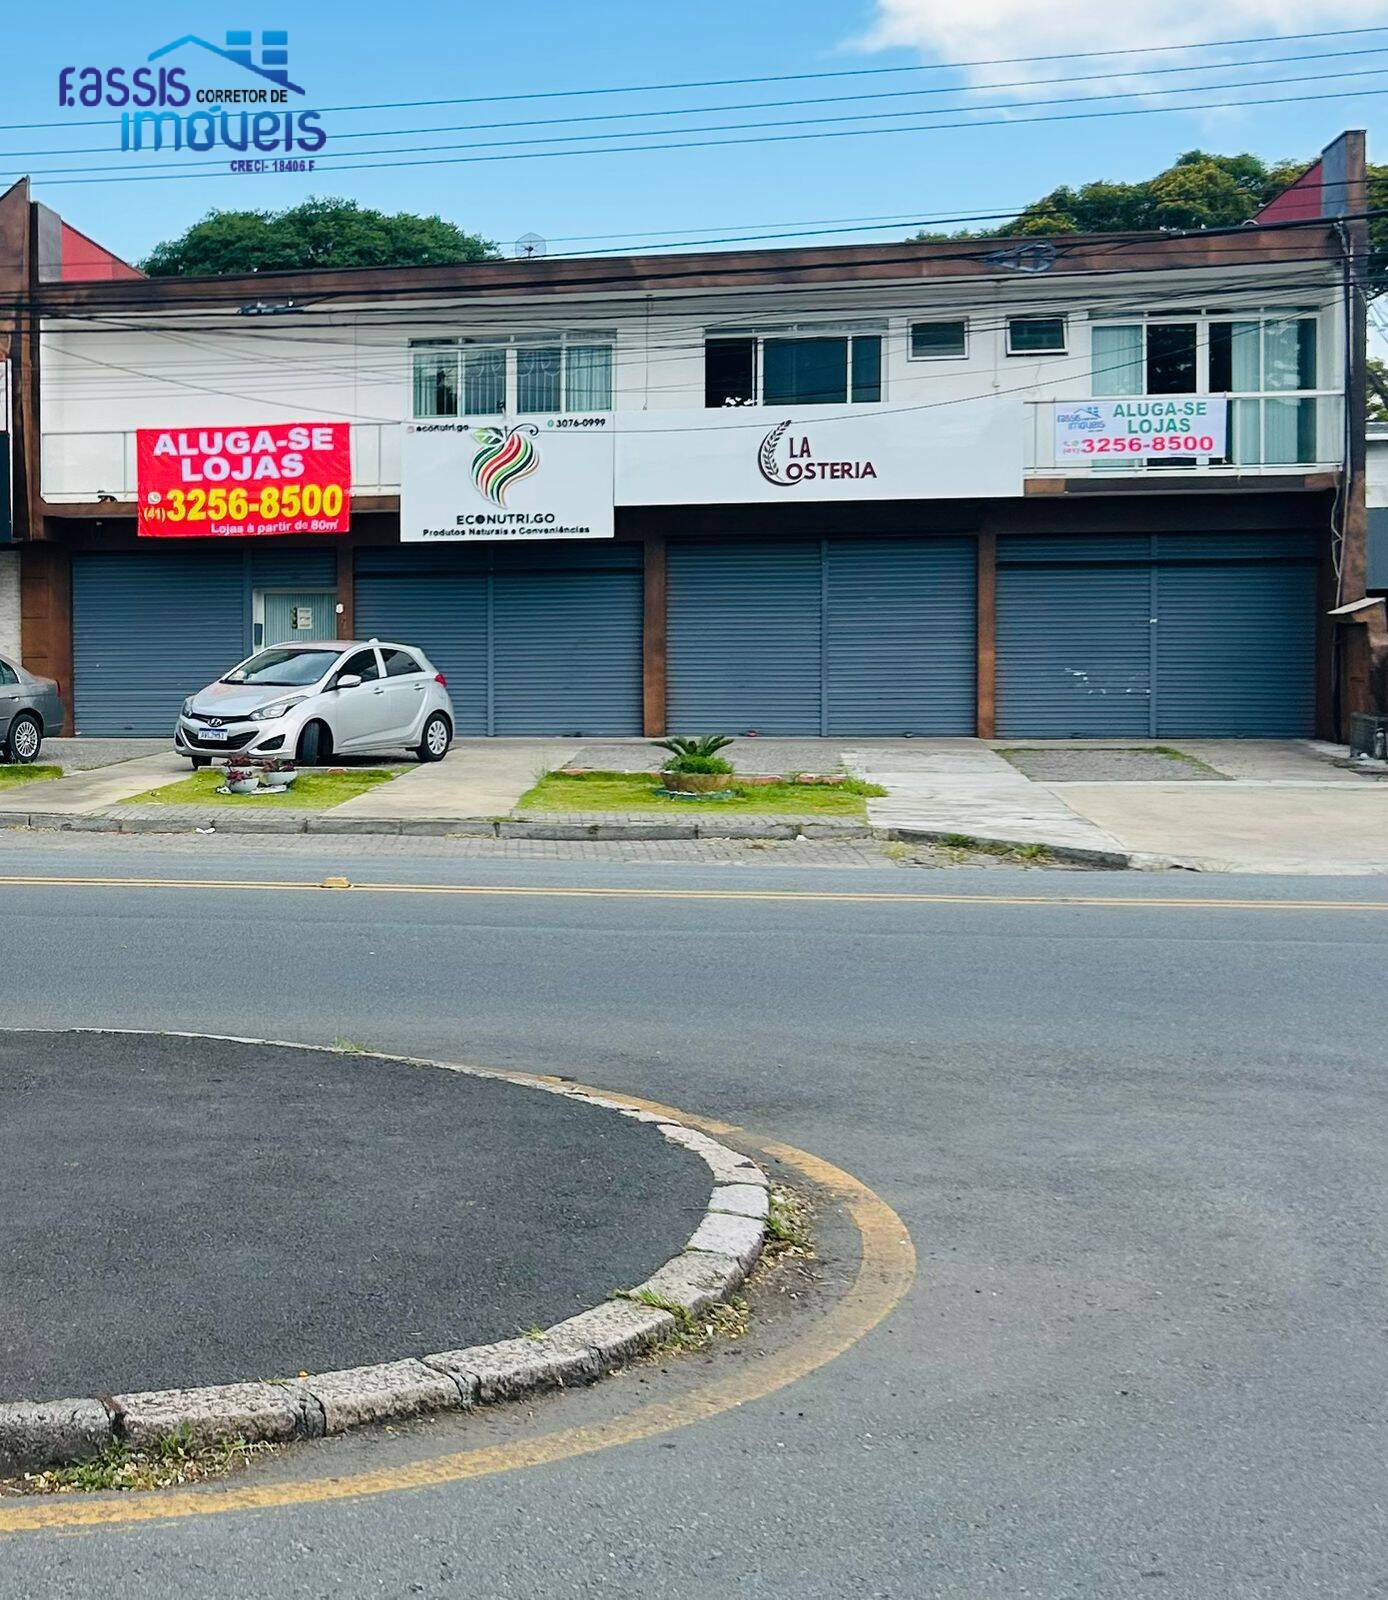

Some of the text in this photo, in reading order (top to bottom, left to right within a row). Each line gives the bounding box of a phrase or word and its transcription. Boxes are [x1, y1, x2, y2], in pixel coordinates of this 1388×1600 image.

[1112, 401, 1207, 418] ALUGA-SE
[556, 418, 606, 428] 3076-0999
[1127, 418, 1191, 434] LOJAS
[153, 427, 335, 456] ALUGA-SE
[789, 436, 811, 458] LA
[1081, 436, 1213, 453] 3256-8500
[181, 453, 305, 482] LOJAS
[785, 461, 877, 480] OSTERIA
[143, 484, 343, 523] (41) 3256-8500
[456, 513, 555, 525] ECONUTRI.GO
[211, 523, 244, 537] Lojas
[257, 521, 291, 535] partir
[294, 520, 309, 531] de
[422, 528, 466, 536] Produtos
[468, 528, 508, 536] Naturais
